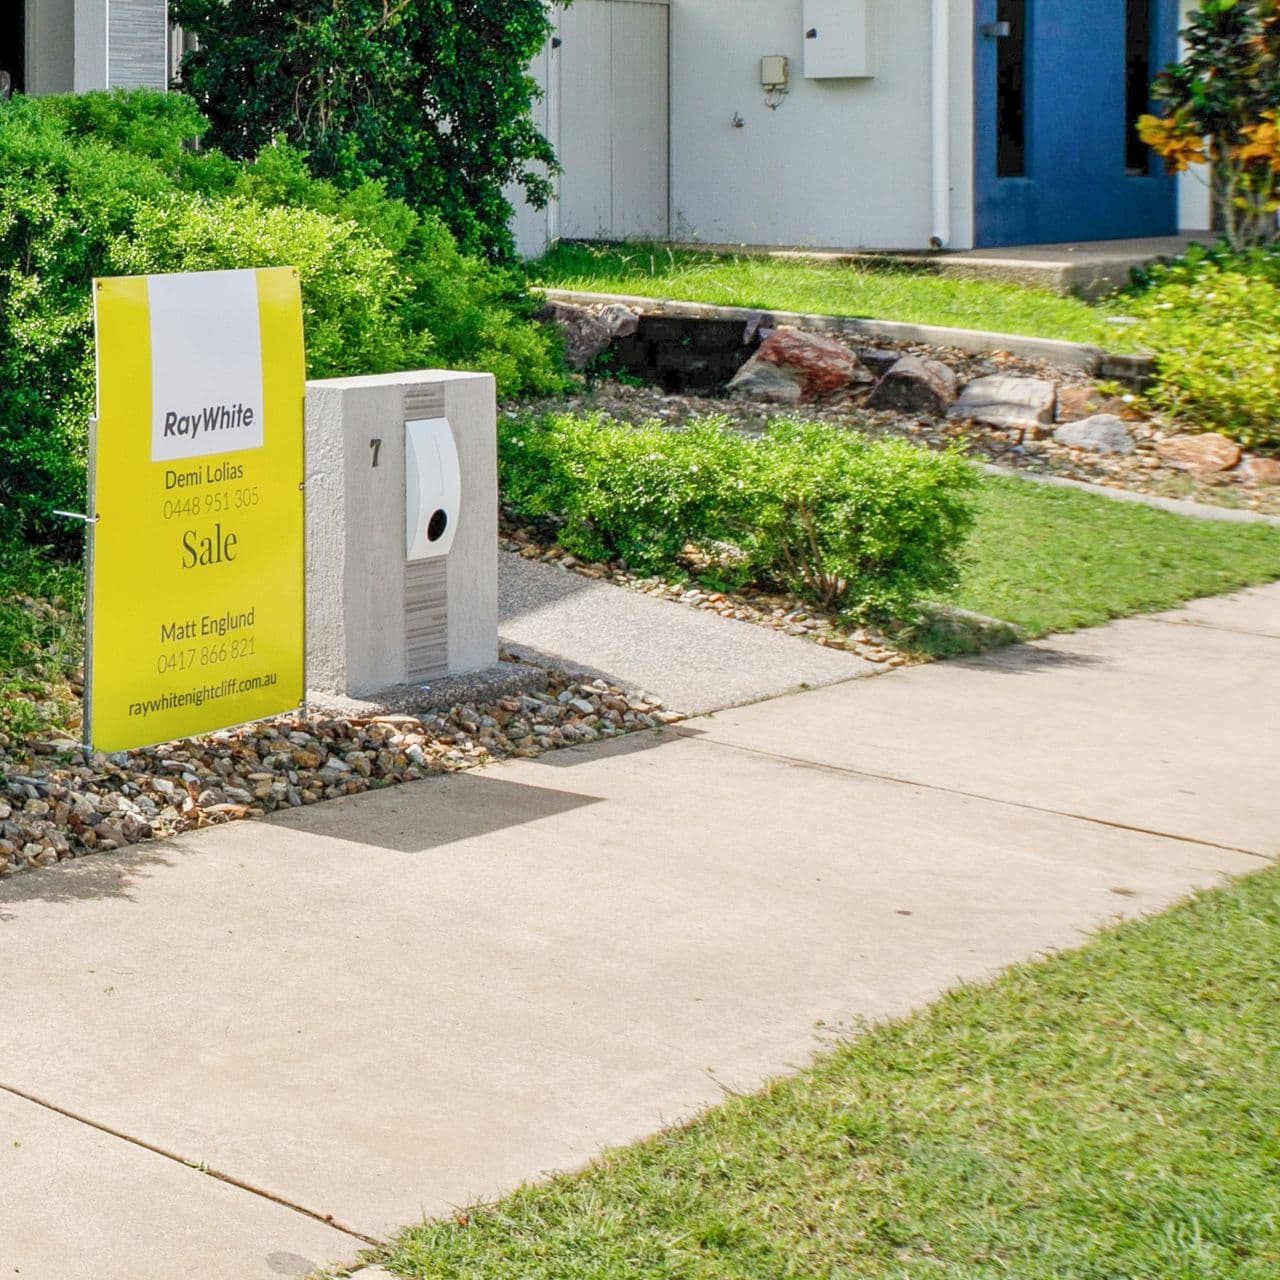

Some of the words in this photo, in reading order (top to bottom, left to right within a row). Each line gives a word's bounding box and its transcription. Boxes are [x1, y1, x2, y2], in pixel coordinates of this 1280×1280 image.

[369, 438, 382, 468] 7
[164, 466, 202, 490] Demi
[206, 462, 244, 484] Lolias
[163, 496, 201, 519] 0448
[205, 491, 230, 512] 951
[234, 486, 259, 508] 305
[182, 523, 238, 569] Sale
[161, 622, 197, 643] Matt
[201, 606, 255, 636] Englund
[157, 648, 196, 674] 0417
[200, 643, 227, 666] 866
[230, 636, 256, 659] 821
[128, 673, 277, 717] raywhitenightcliff.com.au
